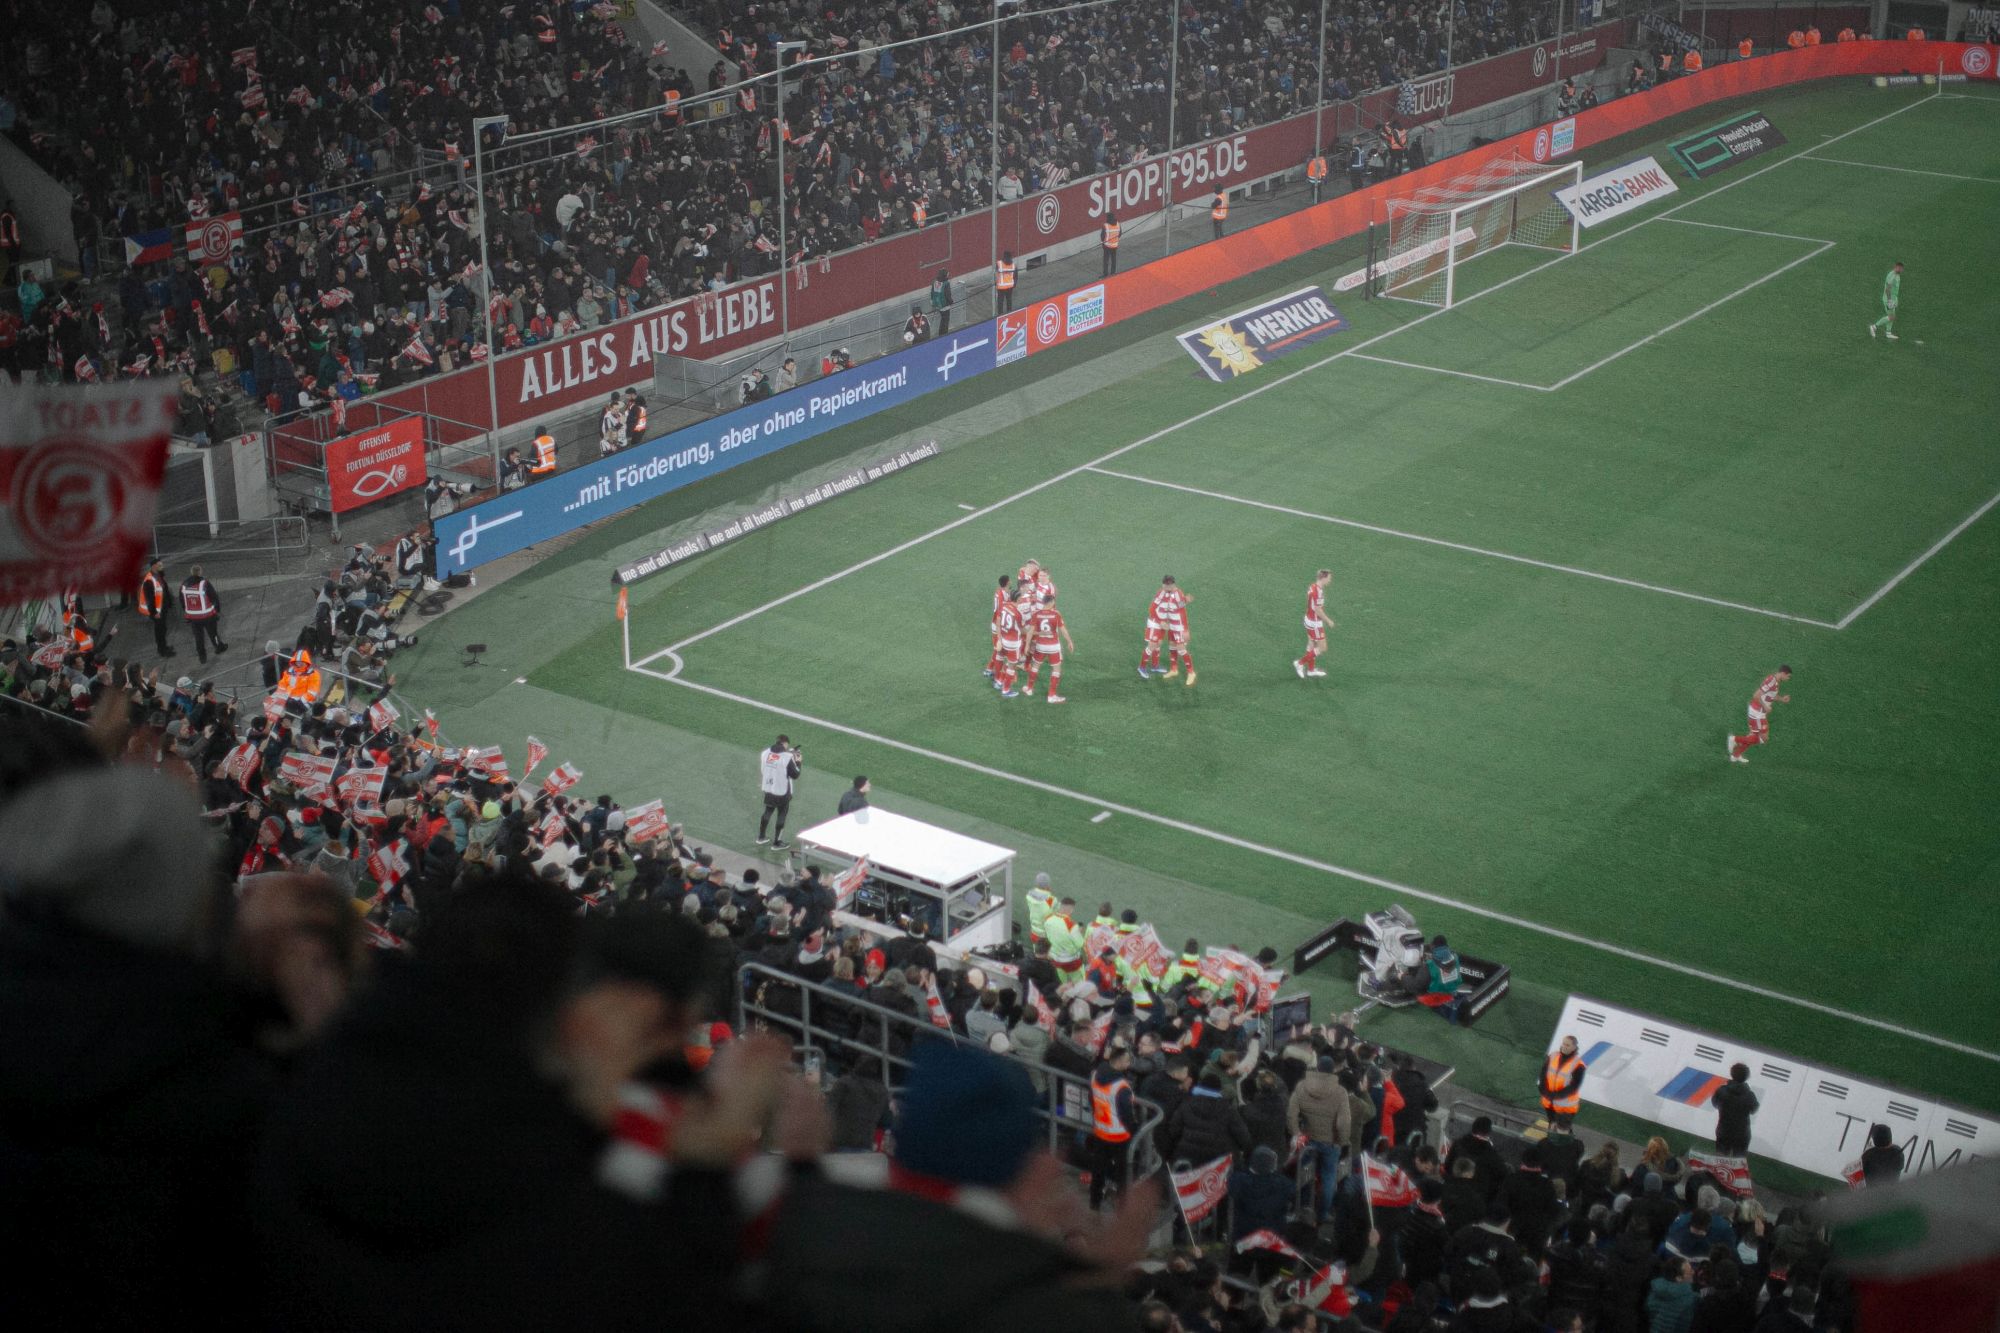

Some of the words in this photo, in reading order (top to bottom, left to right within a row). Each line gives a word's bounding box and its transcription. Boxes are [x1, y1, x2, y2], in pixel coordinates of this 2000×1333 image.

[1720, 128, 1748, 144] Hewlett
[1743, 118, 1770, 134] Packard
[1730, 138, 1763, 154] Enterprise
[1087, 136, 1248, 219] SHOP.F95.DE
[1069, 306, 1103, 326] POSTCODE
[1073, 301, 1100, 315] DEUTSCHE
[1245, 296, 1337, 345] MERKUR
[519, 332, 618, 403] ALLES
[629, 310, 689, 368] AUS
[698, 282, 776, 345] LIEBE
[1016, 331, 1026, 347] 2
[358, 431, 391, 452] OFFENSIVE
[615, 441, 715, 492] Förderung,
[719, 423, 760, 452] aber
[763, 407, 806, 436] ohne
[810, 366, 908, 419] Papierkram!
[345, 455, 375, 473] FORTUNA
[375, 441, 412, 463] DÜSSELDORF
[867, 466, 883, 480] me
[882, 458, 899, 474] and
[898, 453, 909, 467] all
[908, 445, 933, 463] hotels
[790, 495, 805, 511] me
[805, 488, 823, 506] and
[821, 483, 832, 498] all
[833, 475, 860, 494] hotels
[709, 530, 725, 546] me
[724, 521, 742, 539] and
[741, 516, 754, 531] all
[754, 506, 781, 527] hotels
[620, 567, 638, 583] me
[638, 556, 657, 575] and
[657, 552, 669, 569] all
[669, 540, 699, 563] hotels
[1001, 611, 1013, 630] 19
[1039, 618, 1052, 632] 6
